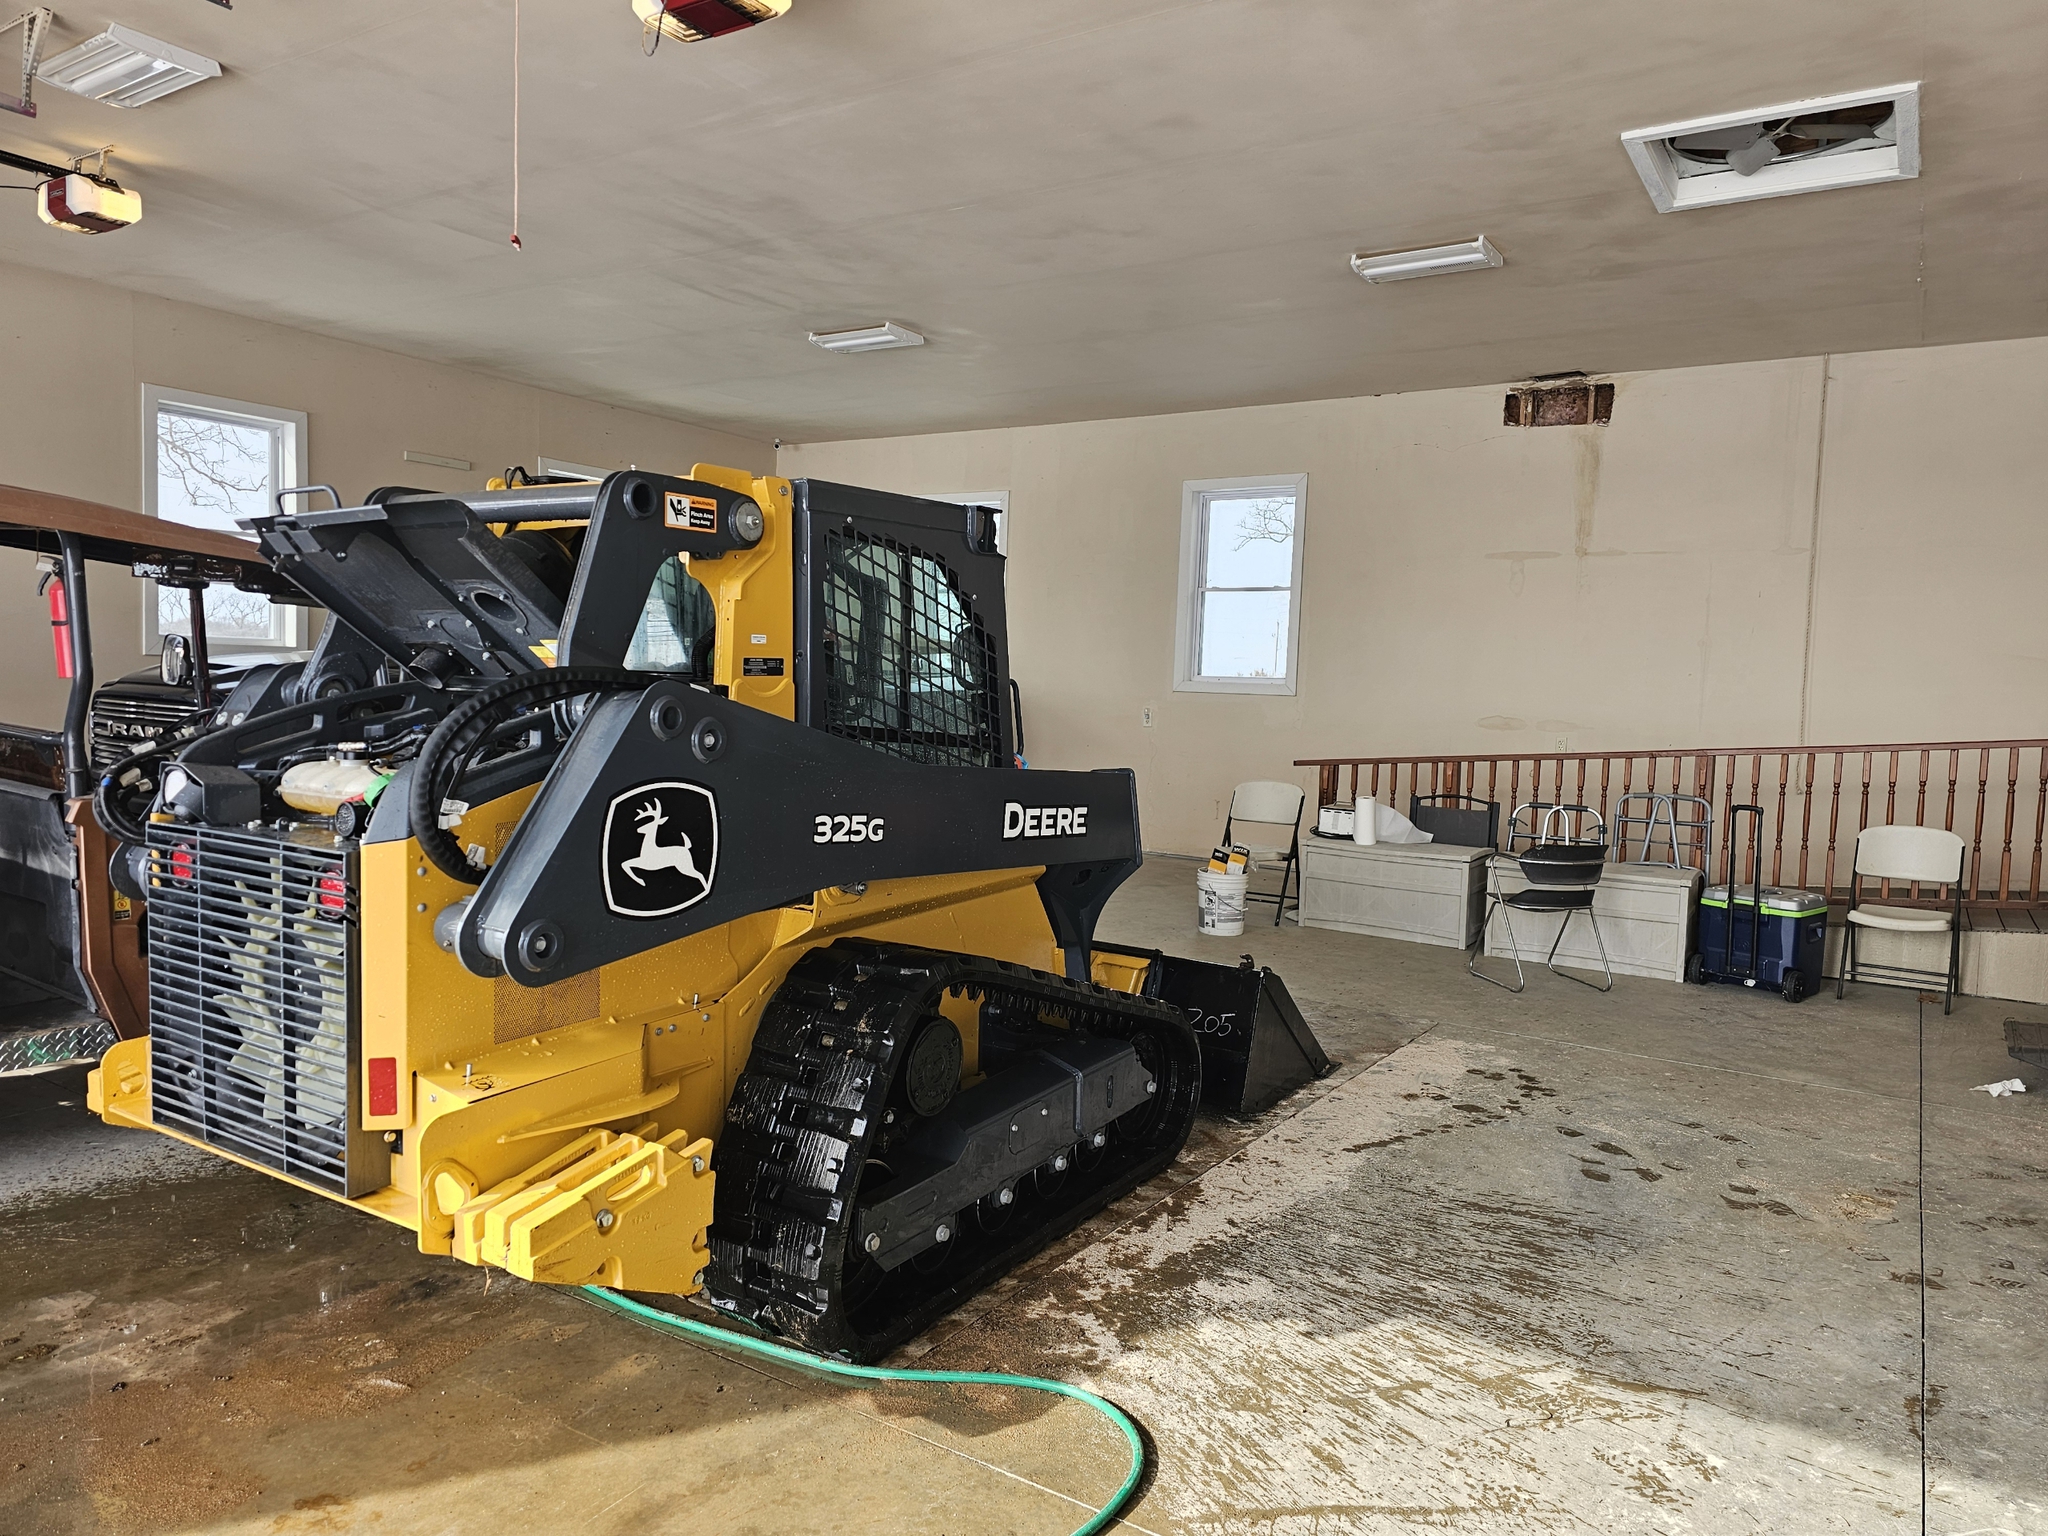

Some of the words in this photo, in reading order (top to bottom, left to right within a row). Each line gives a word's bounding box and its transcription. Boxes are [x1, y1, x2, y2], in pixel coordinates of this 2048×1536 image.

[691, 510, 703, 518] Pinch
[112, 723, 163, 738] RAM
[813, 815, 884, 843] 325G
[1003, 802, 1088, 839] DEERE
